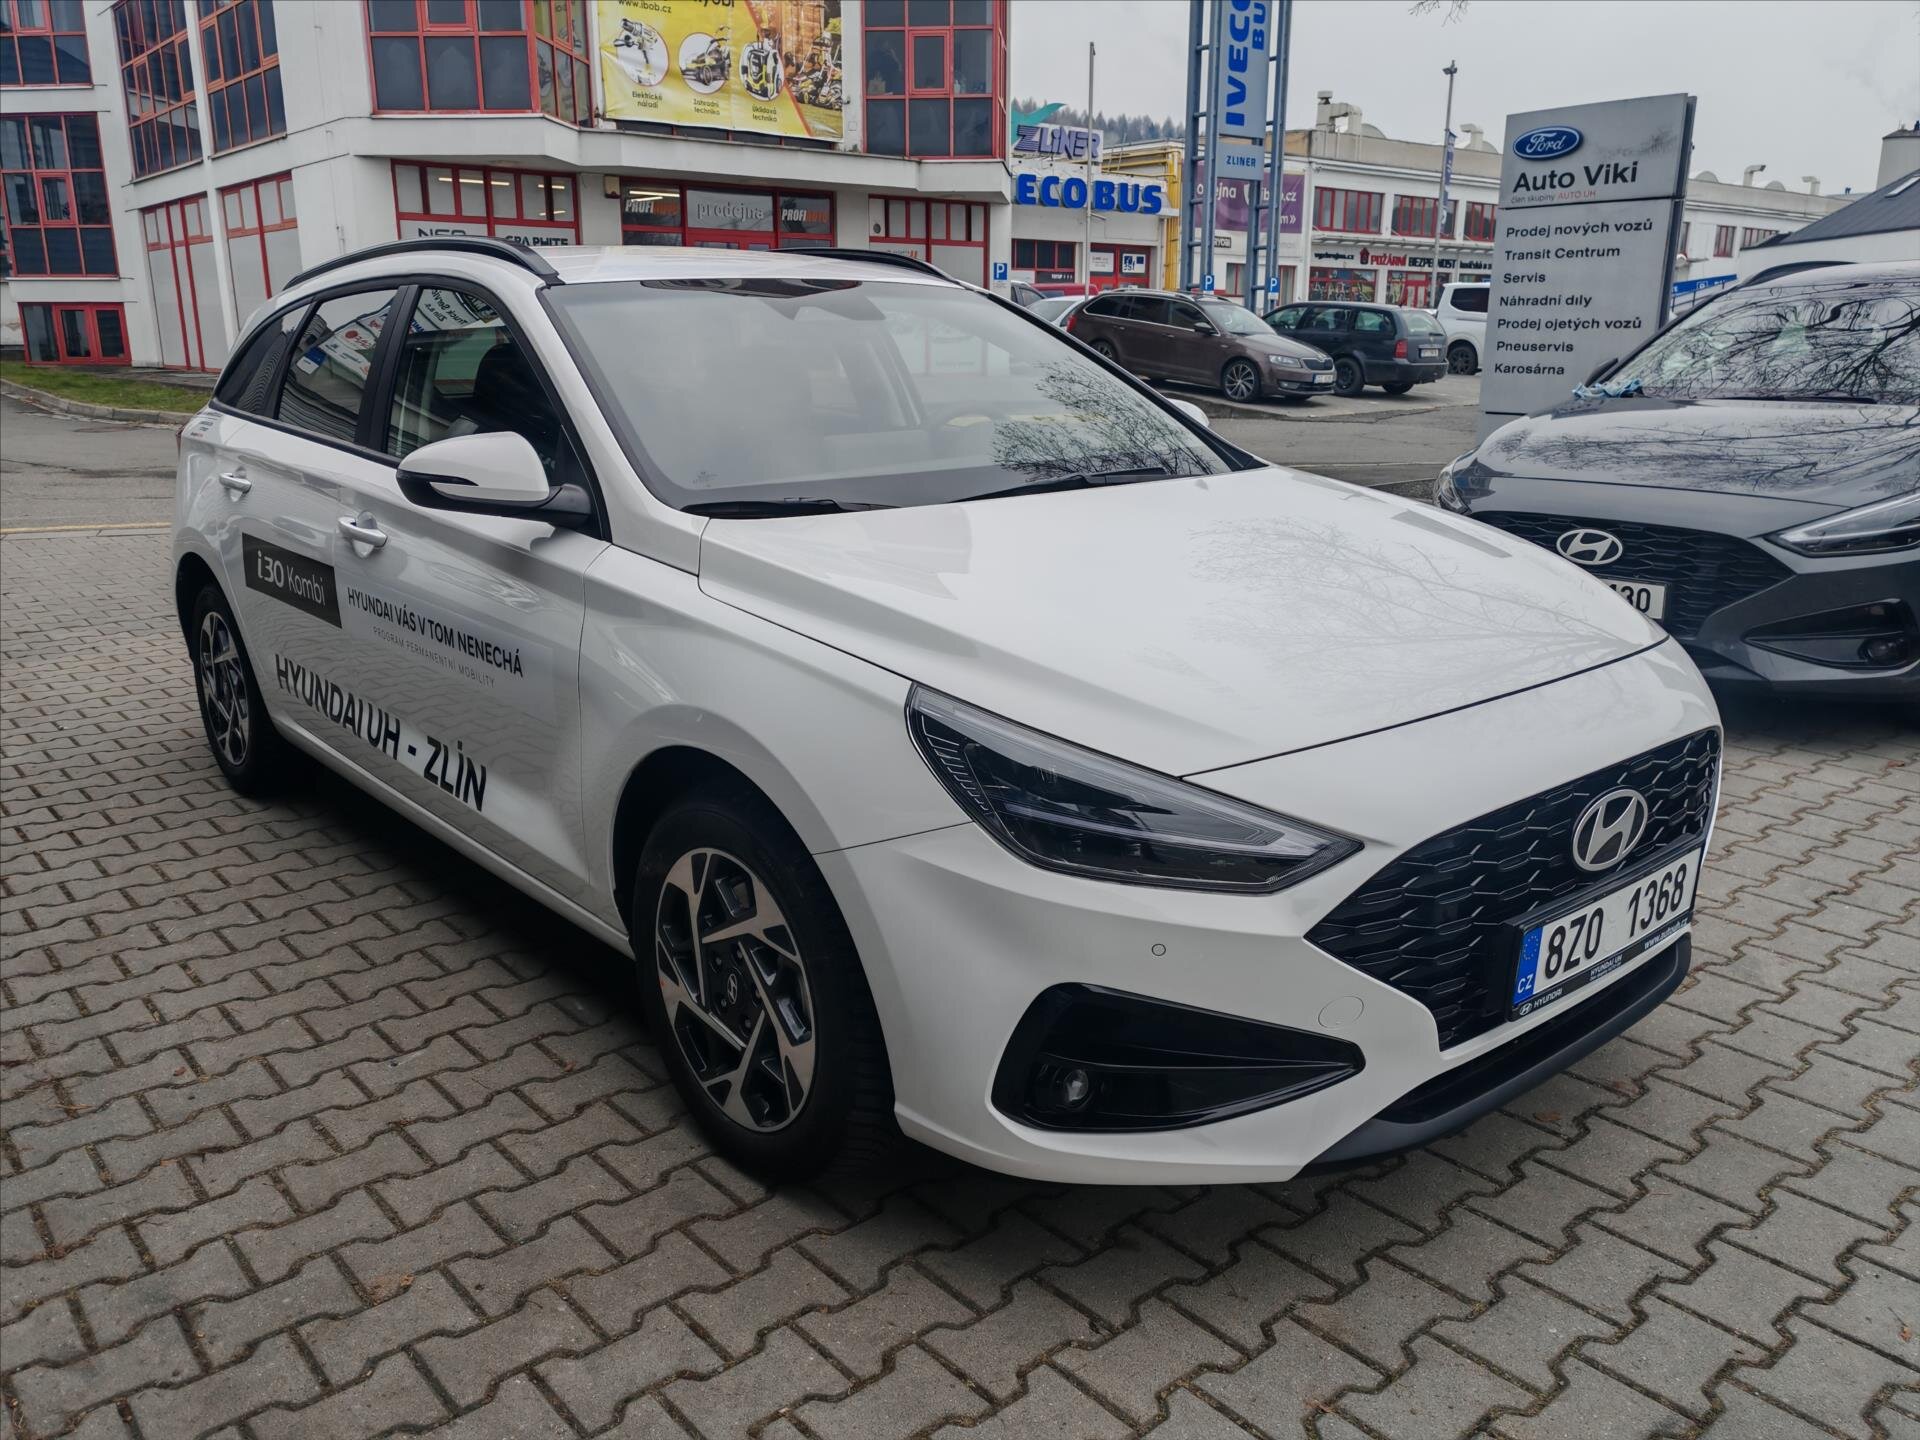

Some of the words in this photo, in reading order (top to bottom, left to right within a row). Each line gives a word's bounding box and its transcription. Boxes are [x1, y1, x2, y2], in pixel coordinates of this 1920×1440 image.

[1526, 132, 1567, 154] Ford
[1226, 155, 1257, 167] ZLINER
[1512, 169, 1575, 193] Auto
[1584, 160, 1639, 186] Viki
[1558, 190, 1581, 200] AUTO
[1583, 190, 1596, 199] UH
[697, 201, 764, 222] prodejna
[1506, 225, 1550, 238] Prodej
[1555, 221, 1609, 236] nových
[1614, 218, 1653, 232] vozů
[1505, 249, 1551, 261] Transit
[1555, 247, 1620, 259] Centrum
[1408, 256, 1457, 269] BEZPENOST
[996, 263, 1005, 279] P
[1503, 272, 1546, 284] Servis
[1205, 276, 1213, 290] P
[1270, 278, 1278, 291] P
[1499, 294, 1562, 307] Náhradní
[1497, 318, 1541, 331] Prodej
[1545, 317, 1600, 331] ojetých
[1605, 316, 1642, 329] vozů
[1496, 341, 1574, 353] Pneuservis
[1494, 362, 1565, 375] Karosárna
[257, 550, 285, 588] i30
[286, 565, 326, 607] Kombi
[347, 587, 393, 622] HYUNDAI
[395, 604, 417, 632] VÁS
[417, 614, 426, 636] V
[427, 619, 455, 649] TOM
[457, 631, 523, 678] NENECHÁ
[372, 626, 404, 648] PROGRAM
[458, 665, 495, 688] MOBILITY
[275, 653, 364, 739] HYUNDAI
[366, 702, 400, 761] UH
[424, 735, 487, 813] ZLÍN
[1627, 863, 1687, 938] 1368
[1517, 973, 1534, 994] CZ
[1533, 988, 1563, 1008] HYUNDAI
